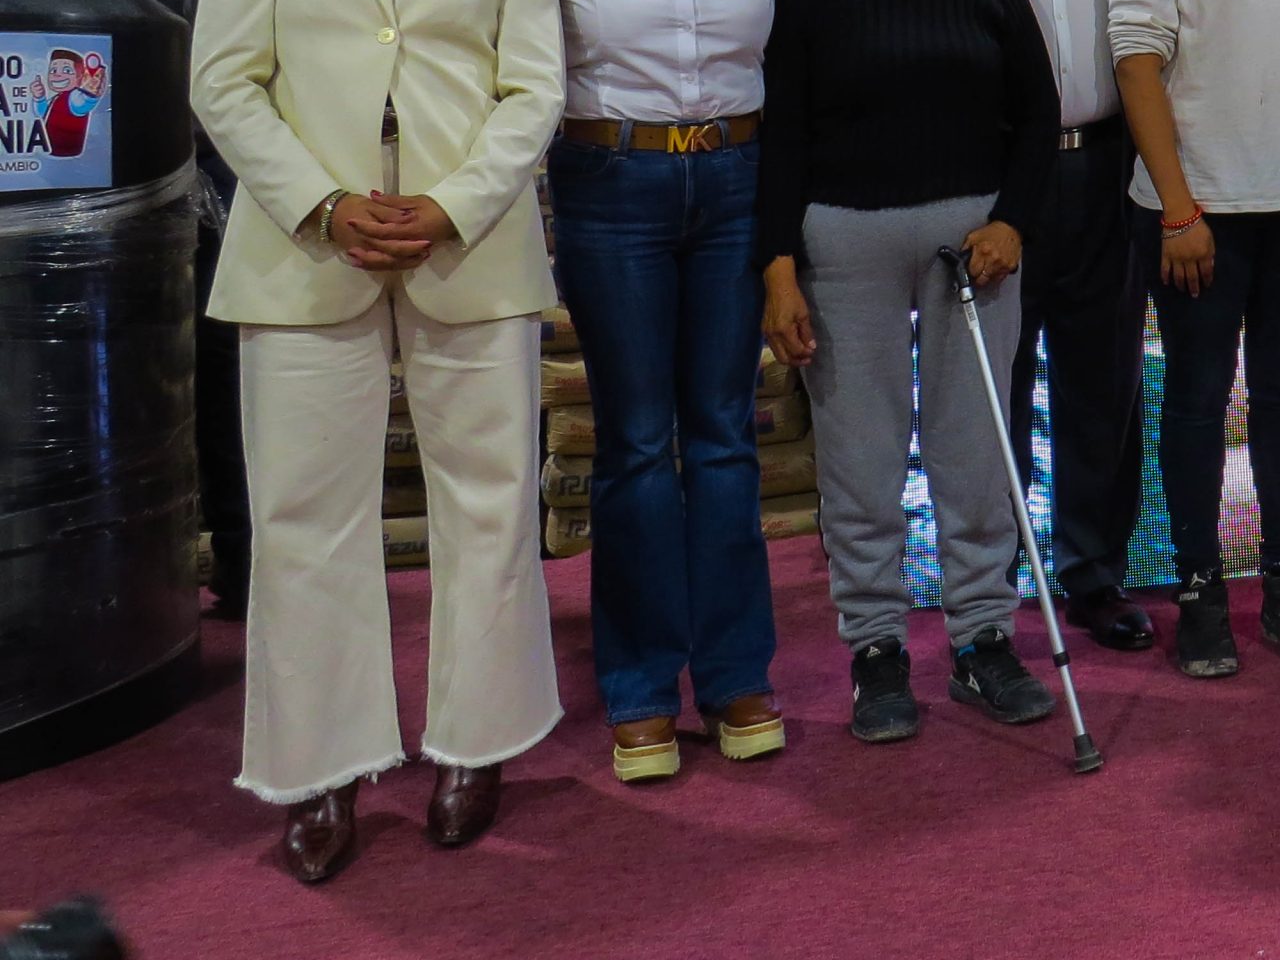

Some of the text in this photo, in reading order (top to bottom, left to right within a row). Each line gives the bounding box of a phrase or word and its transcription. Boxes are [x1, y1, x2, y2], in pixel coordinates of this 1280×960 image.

[13, 87, 27, 97] DE
[14, 103, 27, 113] TU
[667, 124, 714, 153] MK
